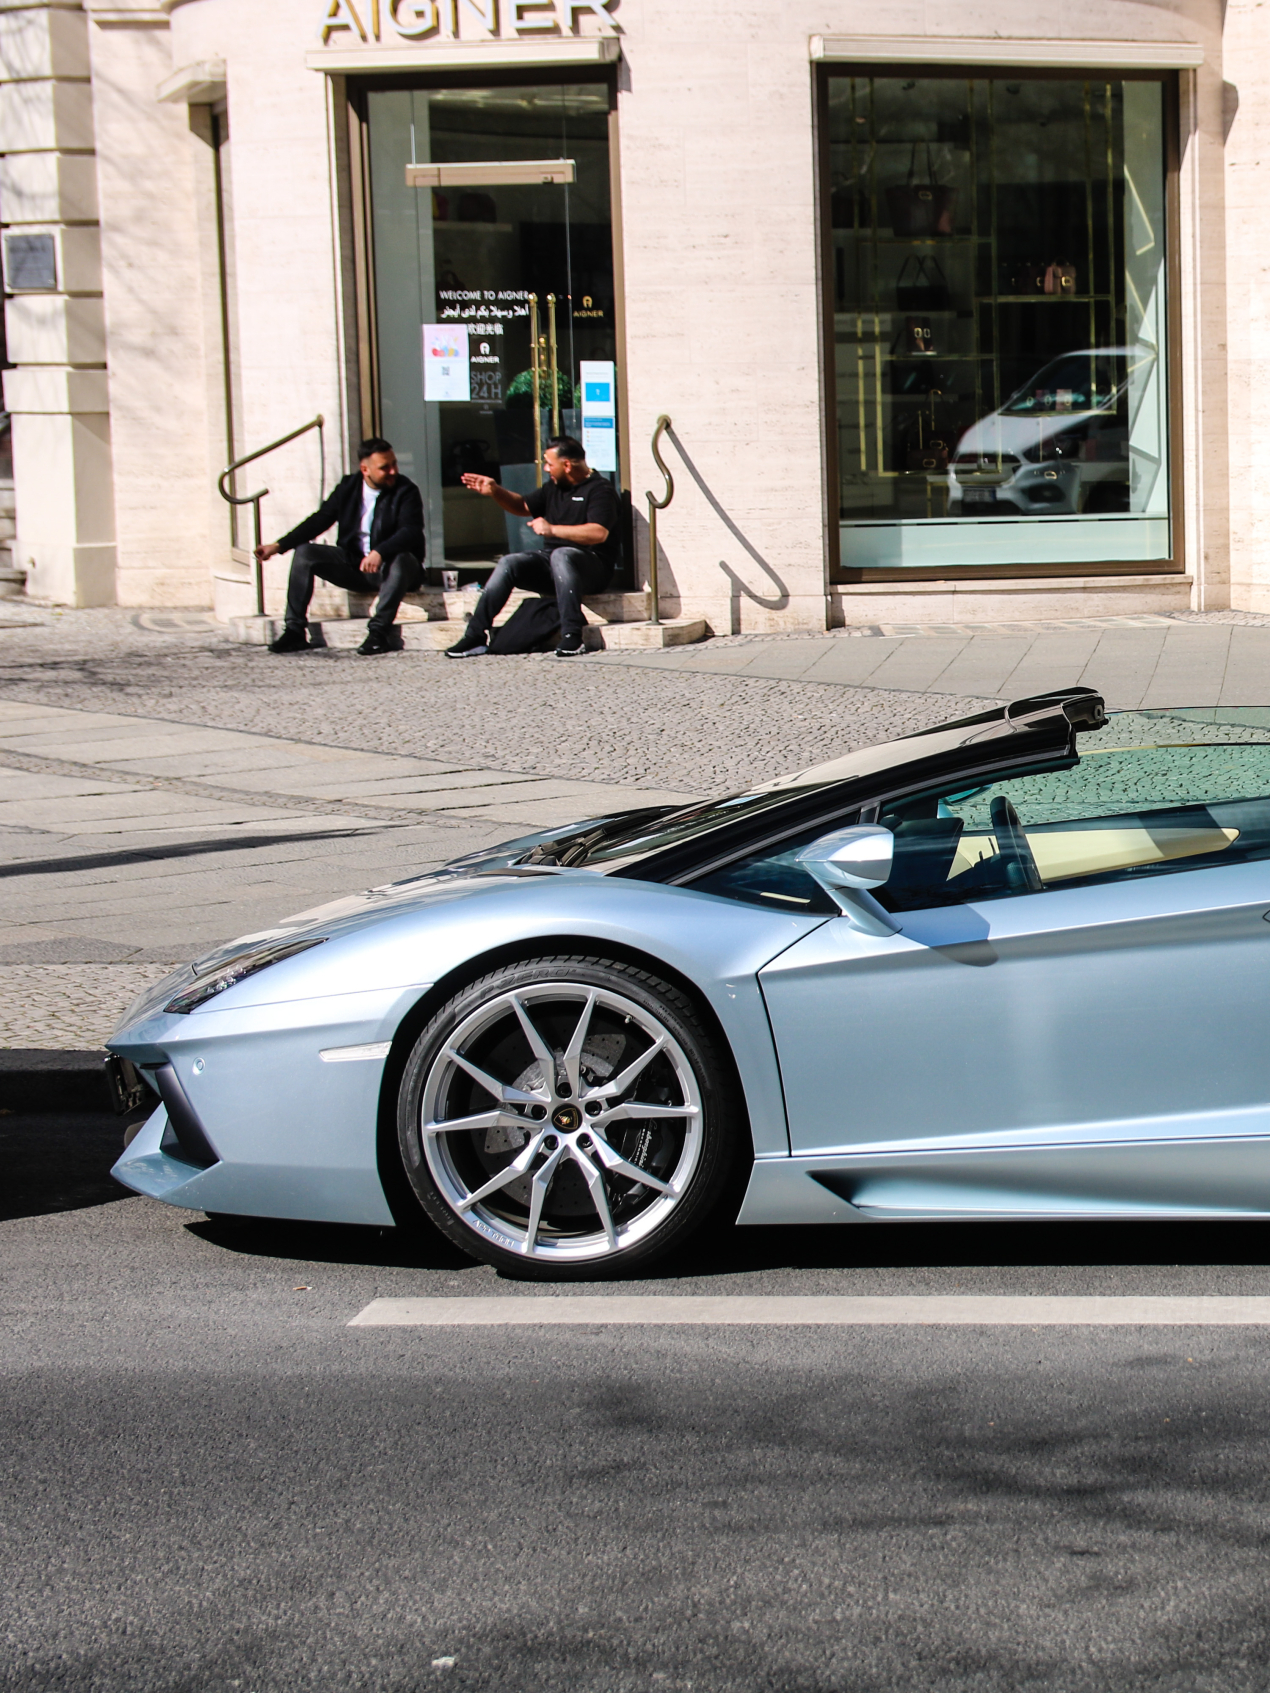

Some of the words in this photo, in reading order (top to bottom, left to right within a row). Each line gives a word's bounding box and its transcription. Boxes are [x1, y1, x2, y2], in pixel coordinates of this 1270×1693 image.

[439, 290, 481, 300] WELCOME
[483, 290, 496, 300] TO
[497, 290, 529, 300] AIGNER
[573, 310, 604, 318] AIGNER
[470, 355, 500, 364] AIGNER
[471, 371, 502, 384] SHOP
